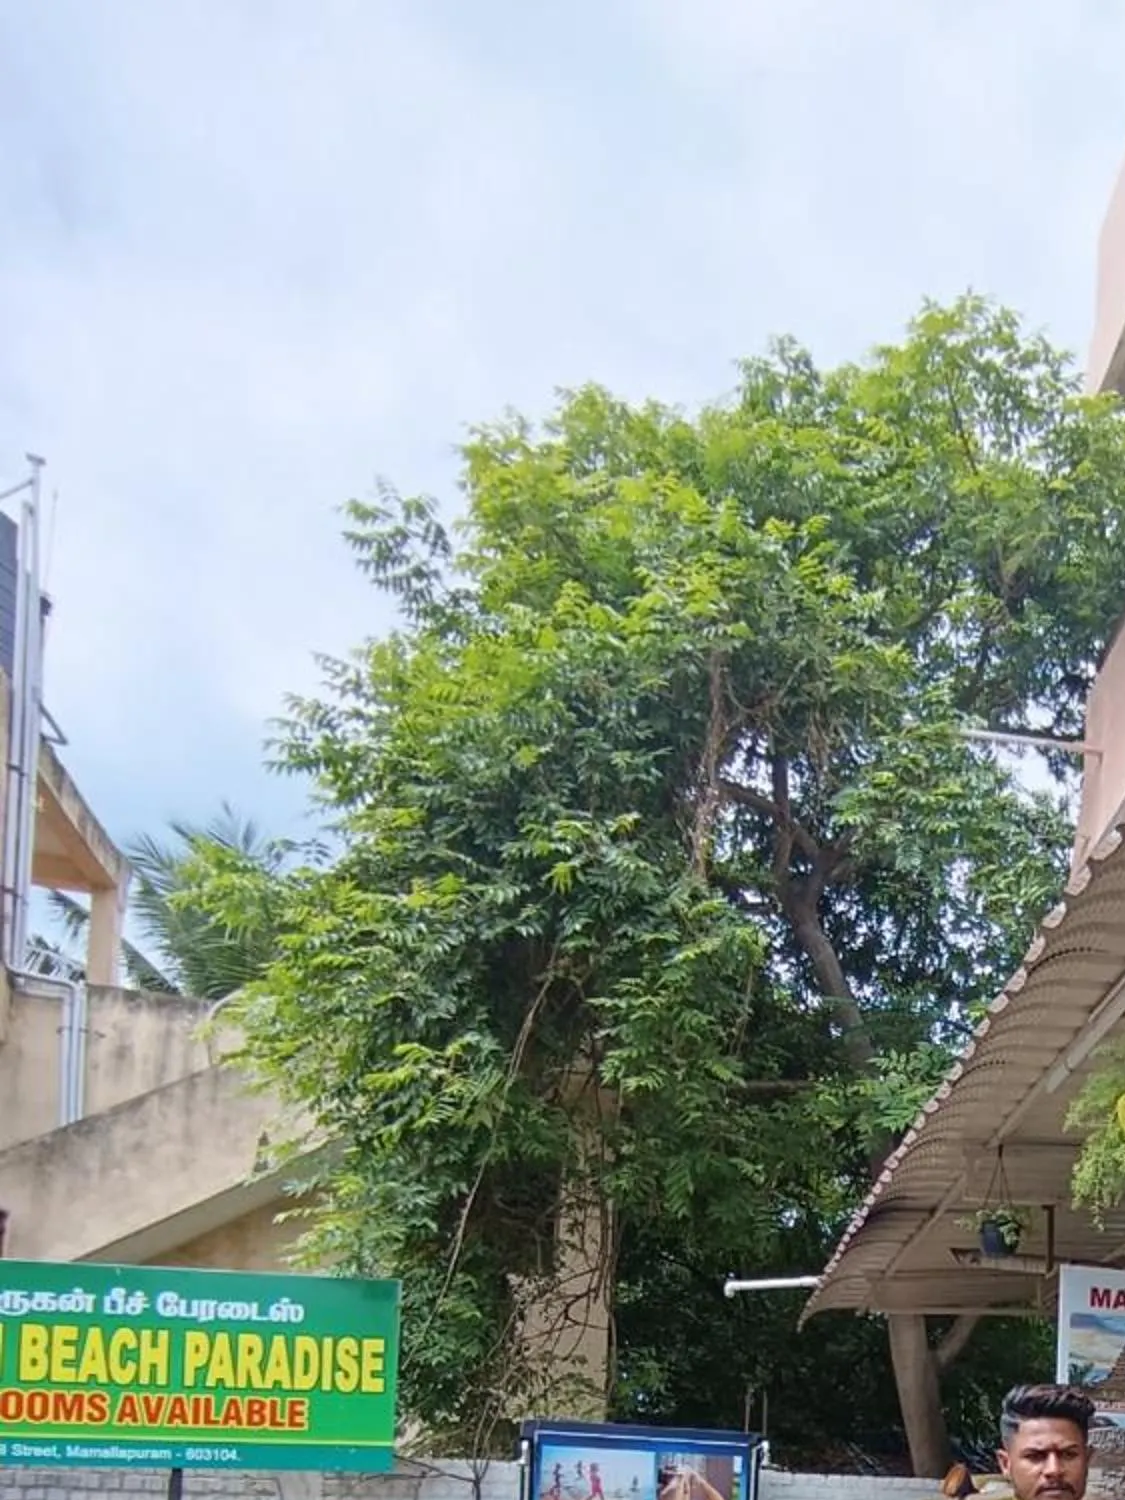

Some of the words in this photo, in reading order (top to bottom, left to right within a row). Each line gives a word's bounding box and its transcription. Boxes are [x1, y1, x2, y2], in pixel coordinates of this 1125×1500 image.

[0, 1287, 96, 1316] ருகன்
[103, 1287, 149, 1316] பீச்
[156, 1291, 305, 1323] பேரடைஸ்
[20, 1324, 169, 1385] BEACH
[184, 1331, 384, 1392] PARADISE
[0, 1388, 109, 1425] OOMS
[114, 1393, 309, 1431] AVAILABLE
[11, 1444, 61, 1459] Street,
[66, 1446, 172, 1463] Mamallapuram
